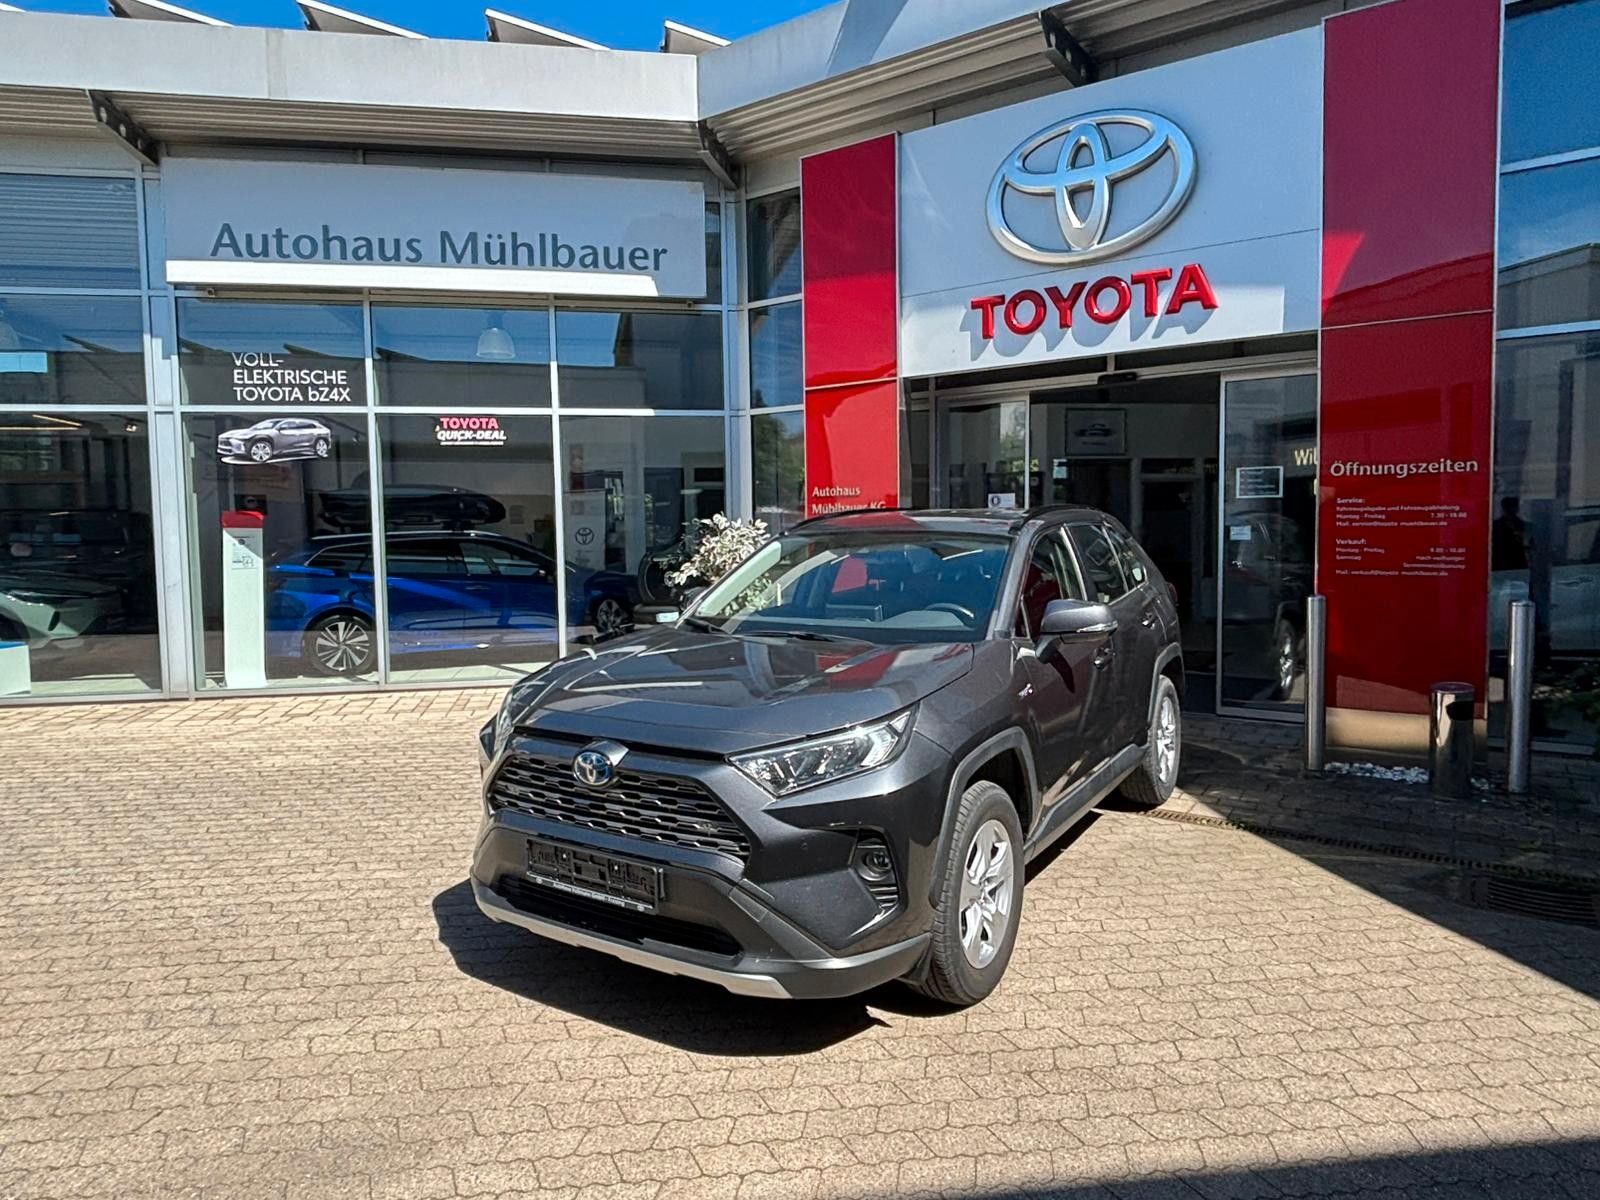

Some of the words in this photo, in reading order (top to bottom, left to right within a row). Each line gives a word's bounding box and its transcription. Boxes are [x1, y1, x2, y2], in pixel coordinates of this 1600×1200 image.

[210, 222, 423, 263] Autohaus
[439, 230, 668, 271] Mühlbauer
[970, 263, 1219, 340] TOYOTA
[231, 352, 284, 367] VOLL-
[233, 369, 348, 385] ELEKTRISCHE
[232, 387, 303, 402] TOYOTA
[308, 386, 352, 402] bZ4X
[440, 417, 499, 429] TOYOTA
[436, 430, 507, 441] QUICK-DEAL
[1330, 458, 1479, 479] Öffnungszeiten
[812, 486, 861, 497] Autohaus
